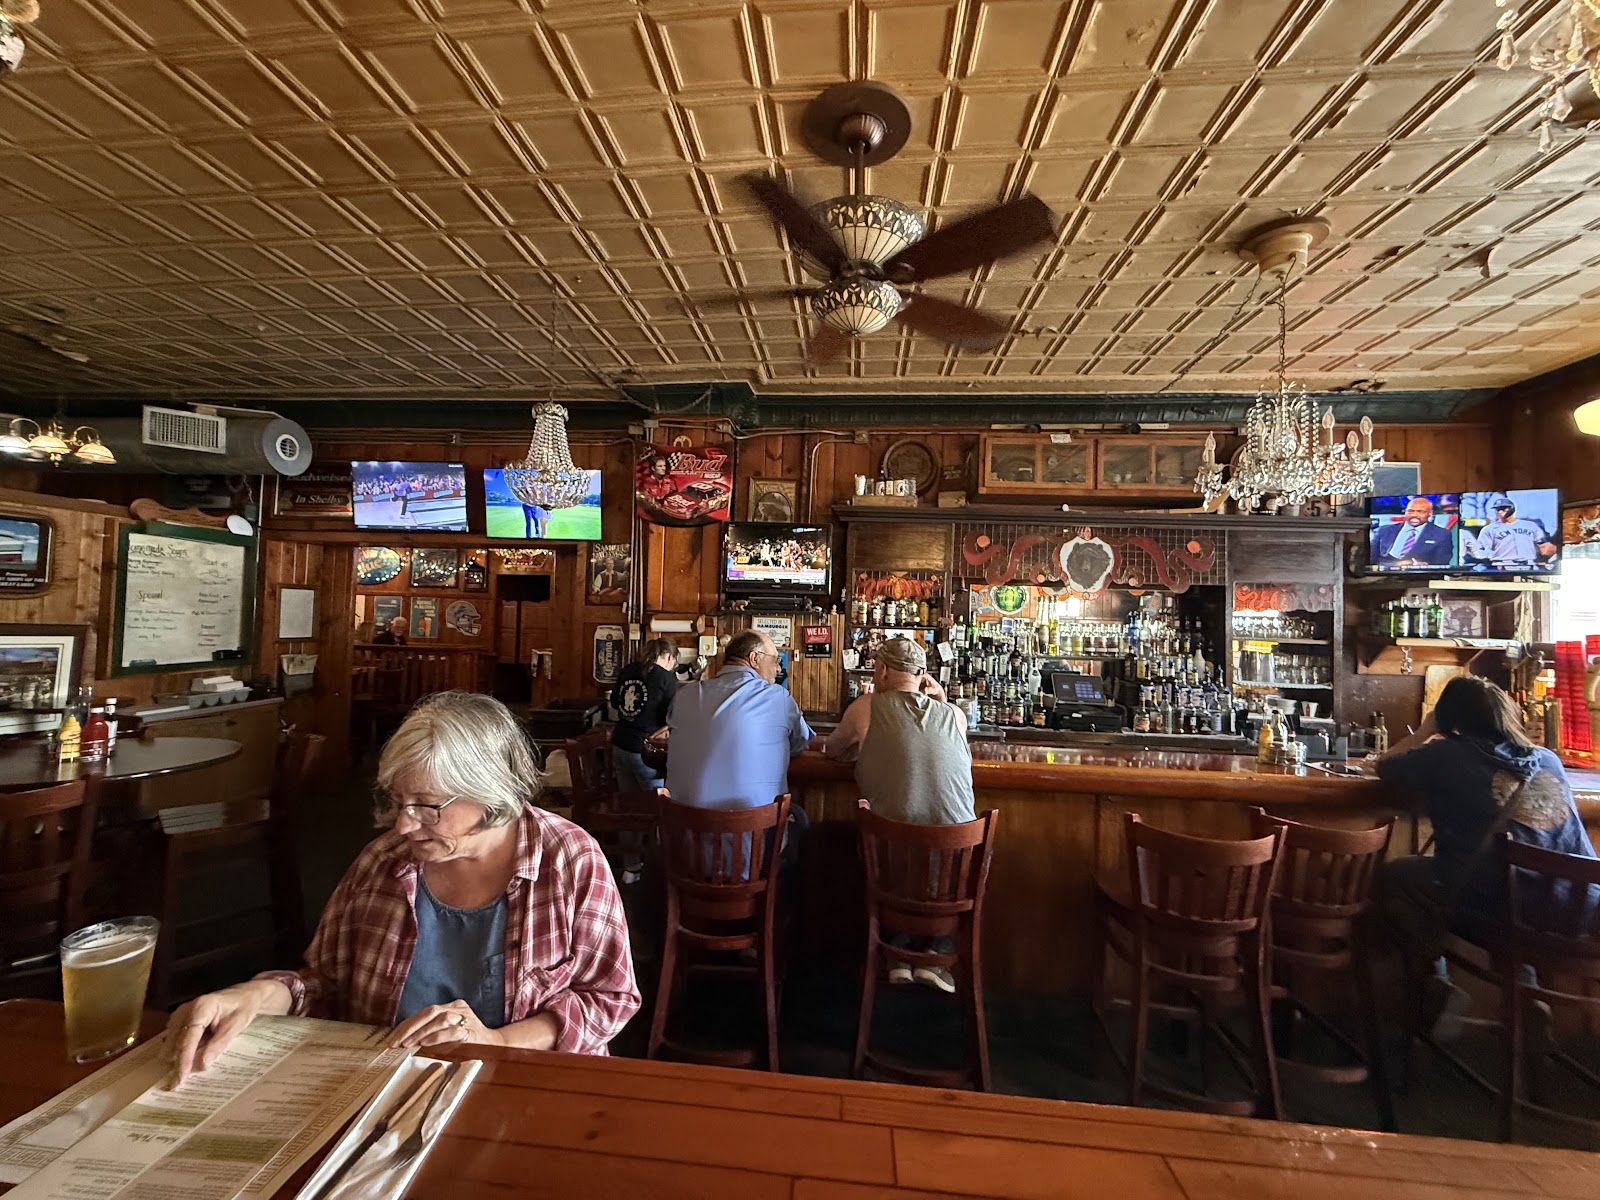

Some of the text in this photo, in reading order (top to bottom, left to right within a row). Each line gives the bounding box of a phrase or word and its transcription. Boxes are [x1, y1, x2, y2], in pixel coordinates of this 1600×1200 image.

[674, 453, 728, 471] Bud
[295, 494, 341, 505] In Shelby
[1496, 527, 1535, 541] NEW YORK
[604, 641, 613, 677] Corona
